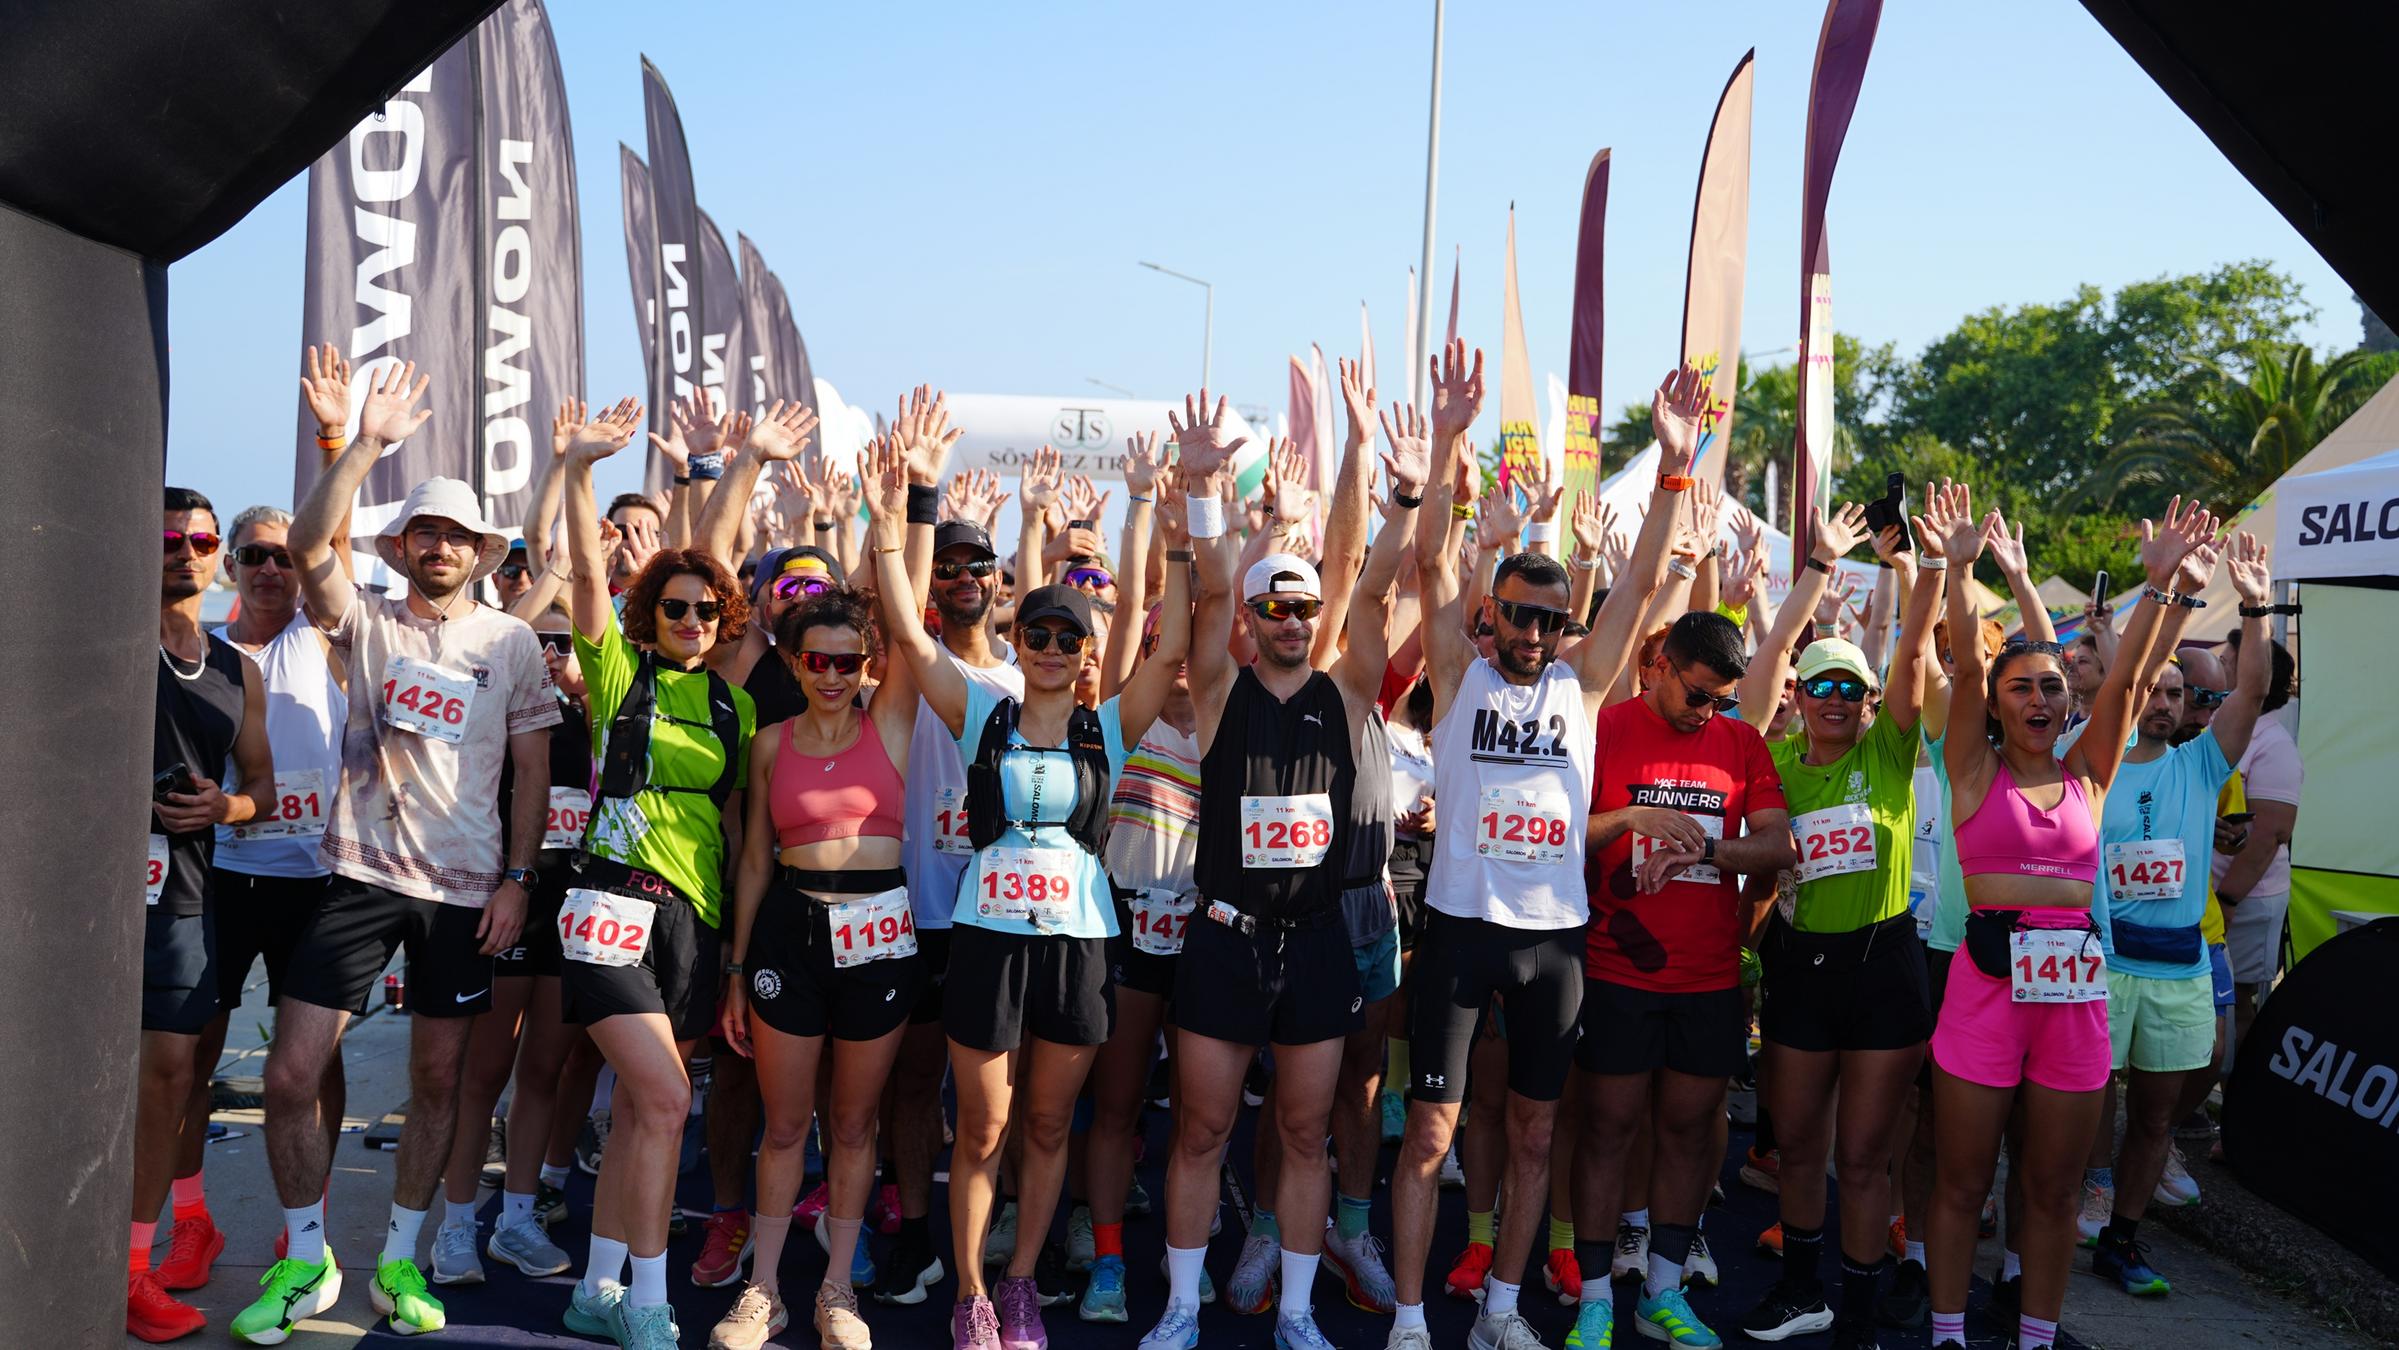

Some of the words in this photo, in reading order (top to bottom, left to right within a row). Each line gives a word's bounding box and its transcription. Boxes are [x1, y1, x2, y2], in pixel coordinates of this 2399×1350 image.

[383, 678, 465, 725] 1426
[1471, 708, 1568, 757] M42.2
[1636, 789, 1721, 809] RUNNERS
[1653, 777, 1677, 790] MAC
[1679, 779, 1707, 789] TEAM
[1245, 818, 1330, 849] 1268
[1482, 811, 1566, 847] 1298
[1812, 819, 1820, 827] 11
[1820, 817, 1831, 825] km
[2020, 863, 2073, 876] MERRELL
[2111, 860, 2184, 886] 1427
[982, 871, 1070, 902] 1389
[560, 911, 644, 951] 1402
[835, 910, 913, 950] 1194
[2015, 955, 2102, 983] 1417
[2269, 1025, 2399, 1134] SALO
